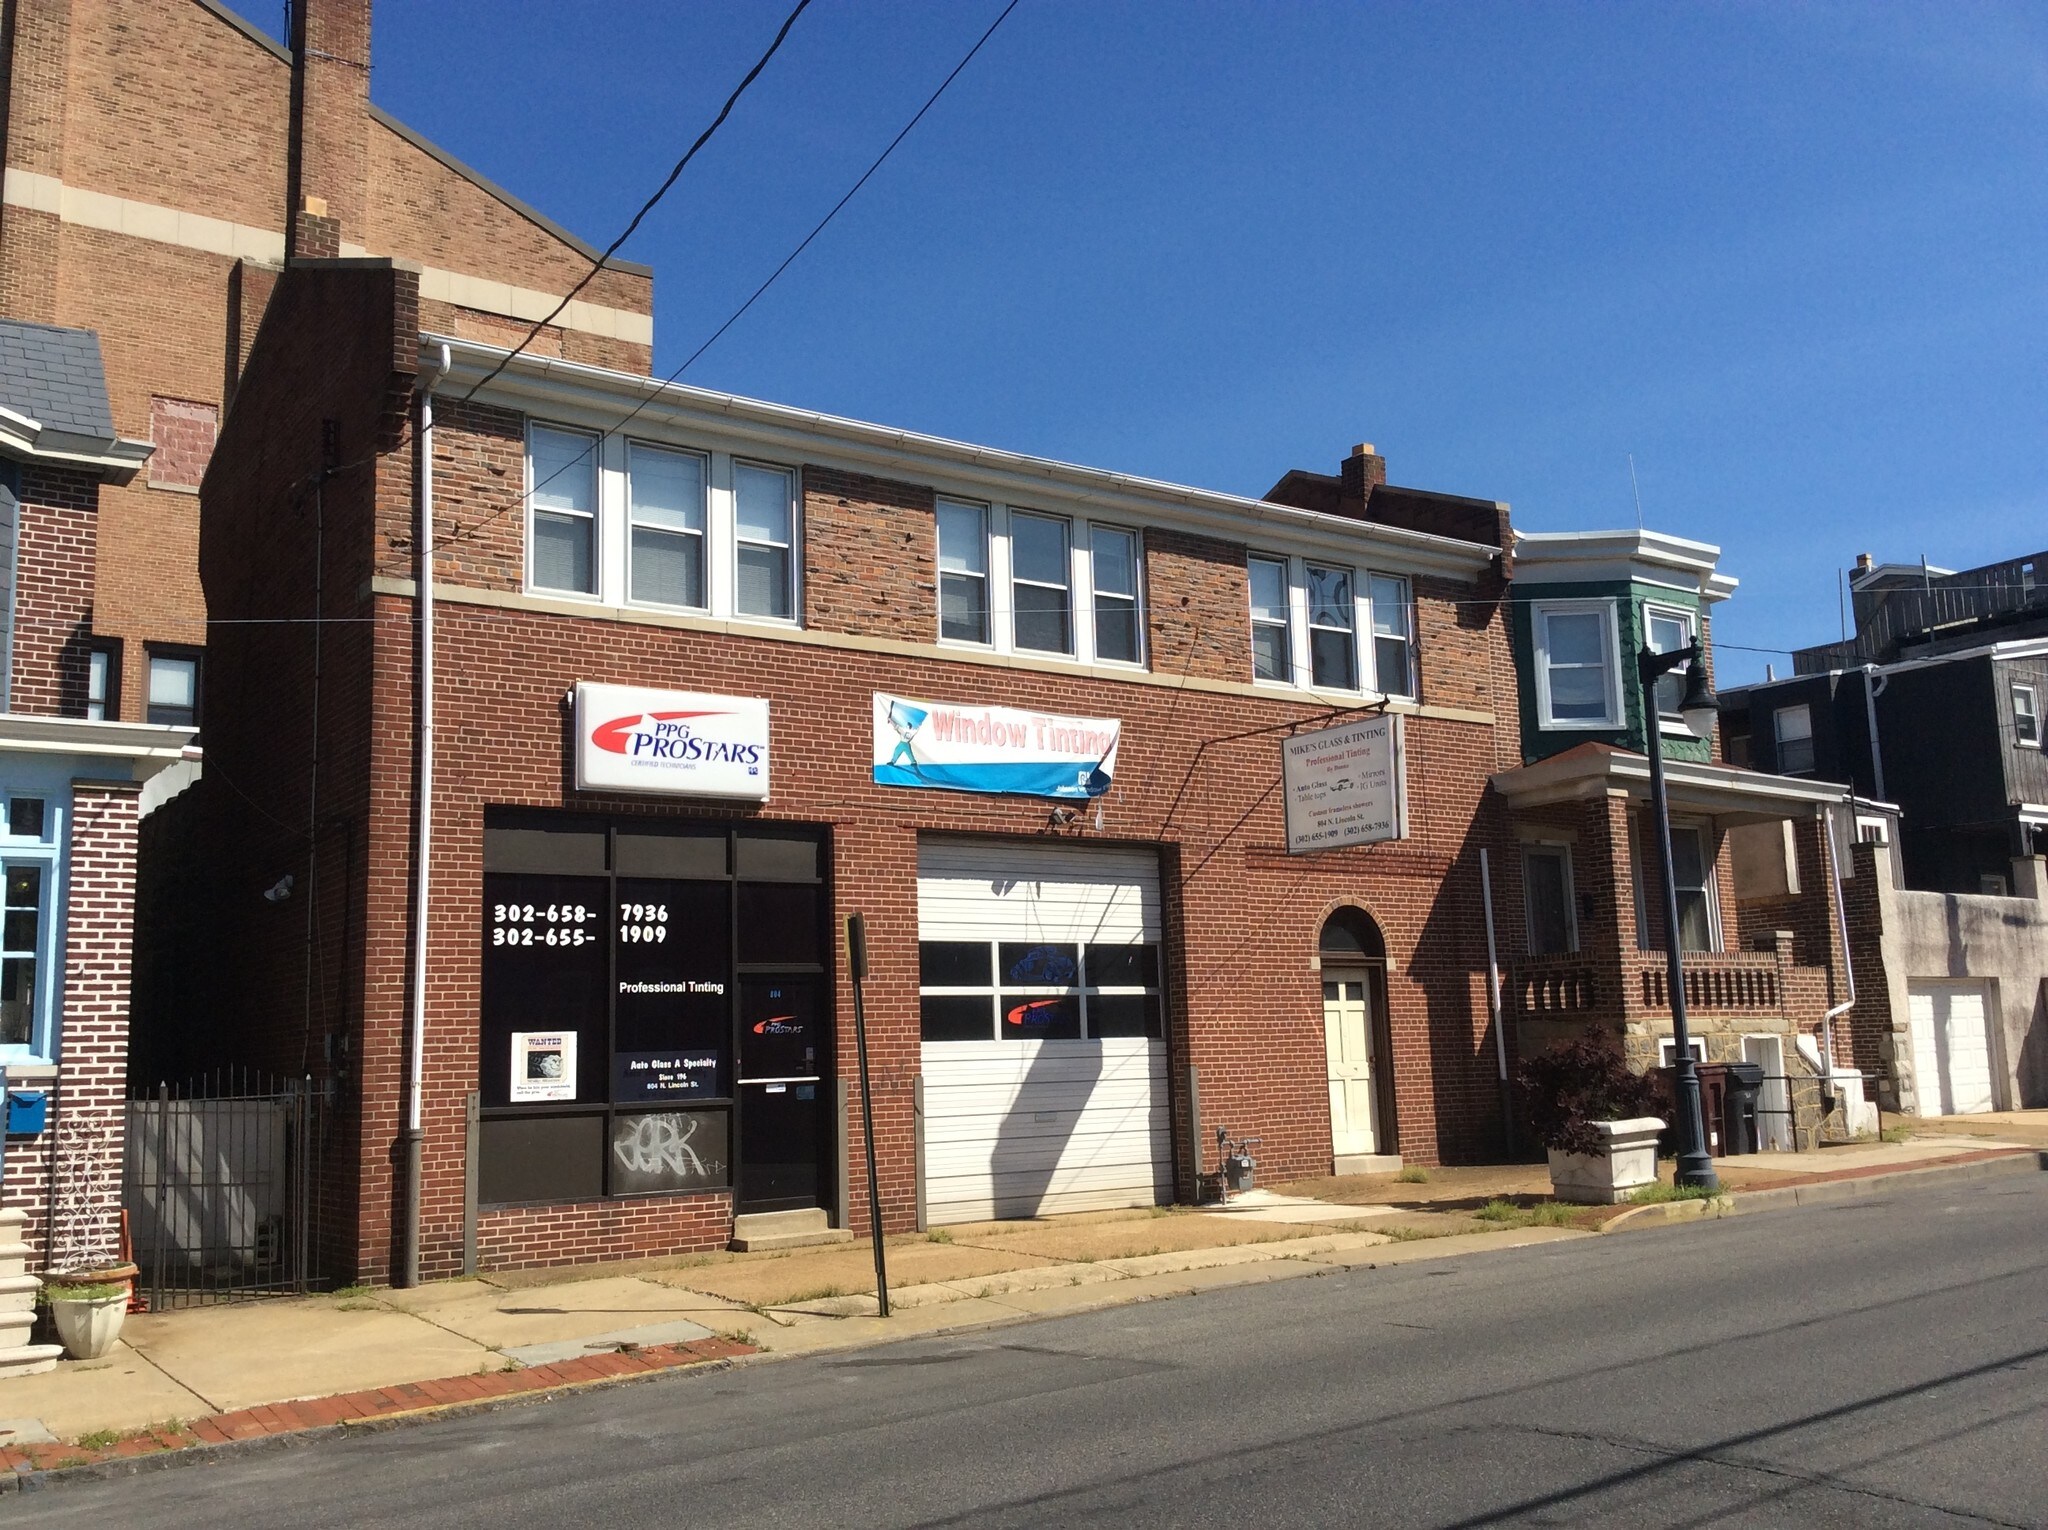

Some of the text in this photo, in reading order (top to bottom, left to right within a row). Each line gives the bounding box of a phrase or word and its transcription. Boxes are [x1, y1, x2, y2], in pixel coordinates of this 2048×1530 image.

[655, 722, 690, 739] PPG
[931, 708, 1111, 756] Window Tinting
[1290, 728, 1386, 756] MIKE'S GLASS & TINTING
[1306, 747, 1371, 767] Professional Tinting
[1361, 769, 1385, 779] Mirrors
[1296, 781, 1328, 793] Auto Glass
[1344, 824, 1360, 837] (302)
[493, 903, 669, 923] 302-658- 7936
[492, 925, 667, 947] 302-655- 1909
[619, 981, 724, 995] Professional Tinting
[527, 1038, 562, 1046] WANTED
[630, 1058, 716, 1070] Auto Glass A Specialty
